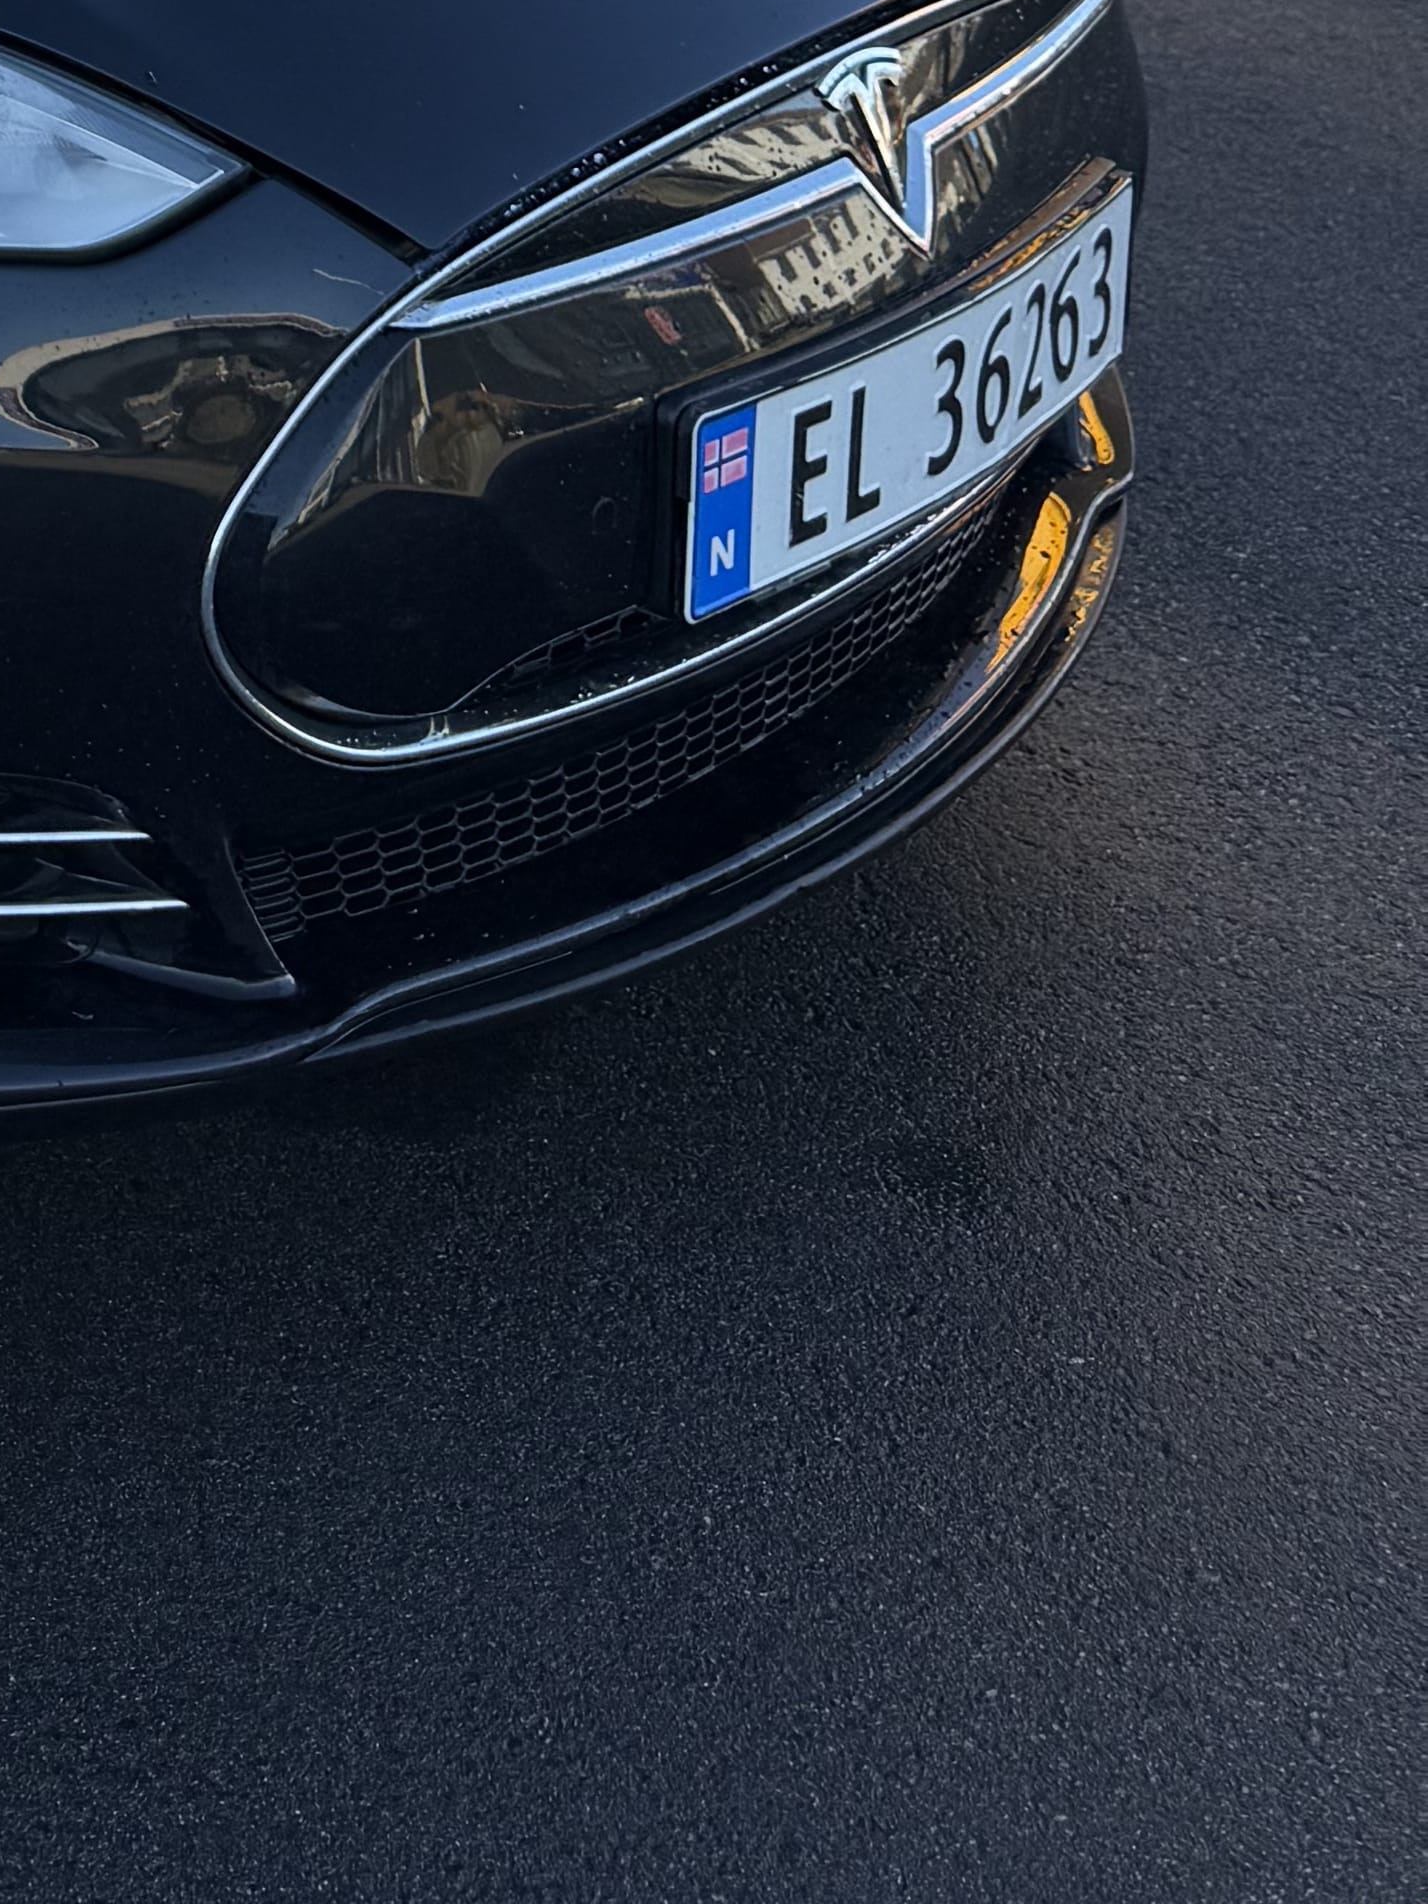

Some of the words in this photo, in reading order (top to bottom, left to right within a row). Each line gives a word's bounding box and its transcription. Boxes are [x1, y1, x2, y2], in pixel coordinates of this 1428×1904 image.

[788, 385, 882, 549] EL
[926, 225, 1114, 477] 36263
[709, 528, 735, 577] N
